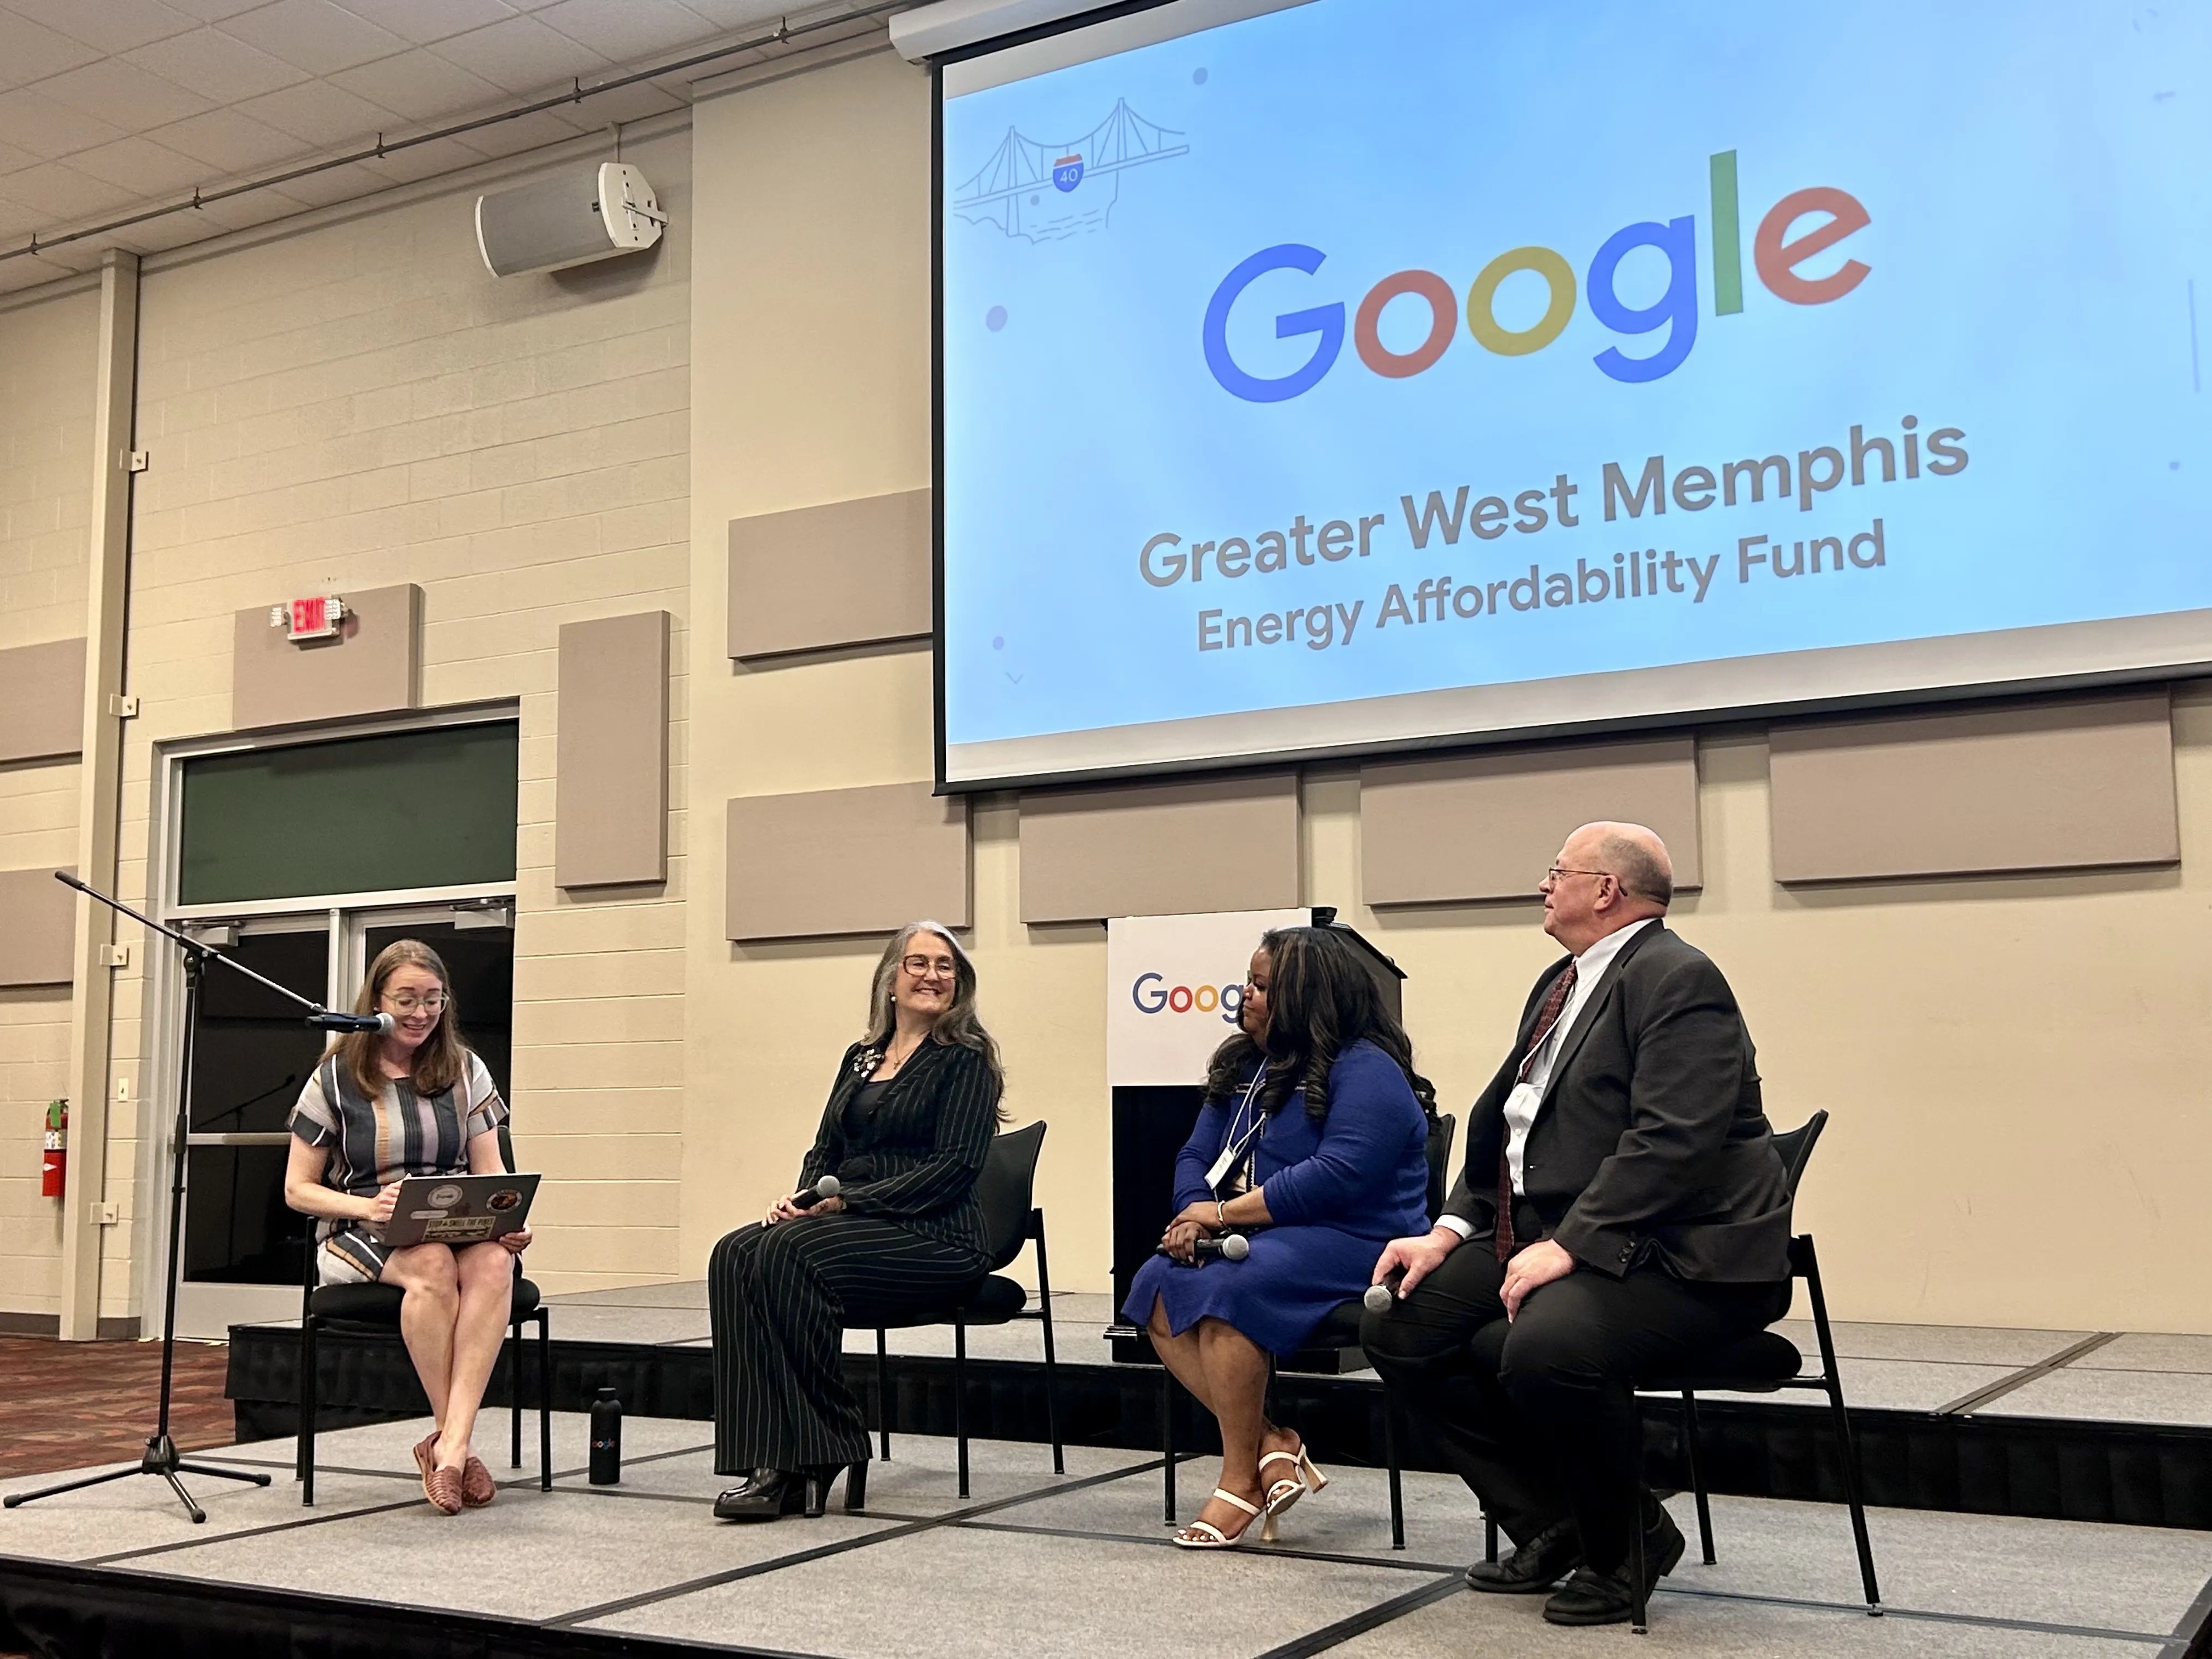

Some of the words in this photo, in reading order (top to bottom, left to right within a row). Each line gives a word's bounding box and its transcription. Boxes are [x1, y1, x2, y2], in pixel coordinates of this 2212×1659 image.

[1059, 168, 1079, 182] 40
[1203, 149, 1871, 403] Google
[1140, 514, 1383, 587] Greater
[1401, 475, 1577, 549] West
[1602, 415, 1968, 520] Memphis
[1199, 602, 1361, 651] Energy
[1376, 551, 1717, 627] Affordability
[1738, 520, 1884, 581] Fund
[1133, 972, 1245, 1024] Goog
